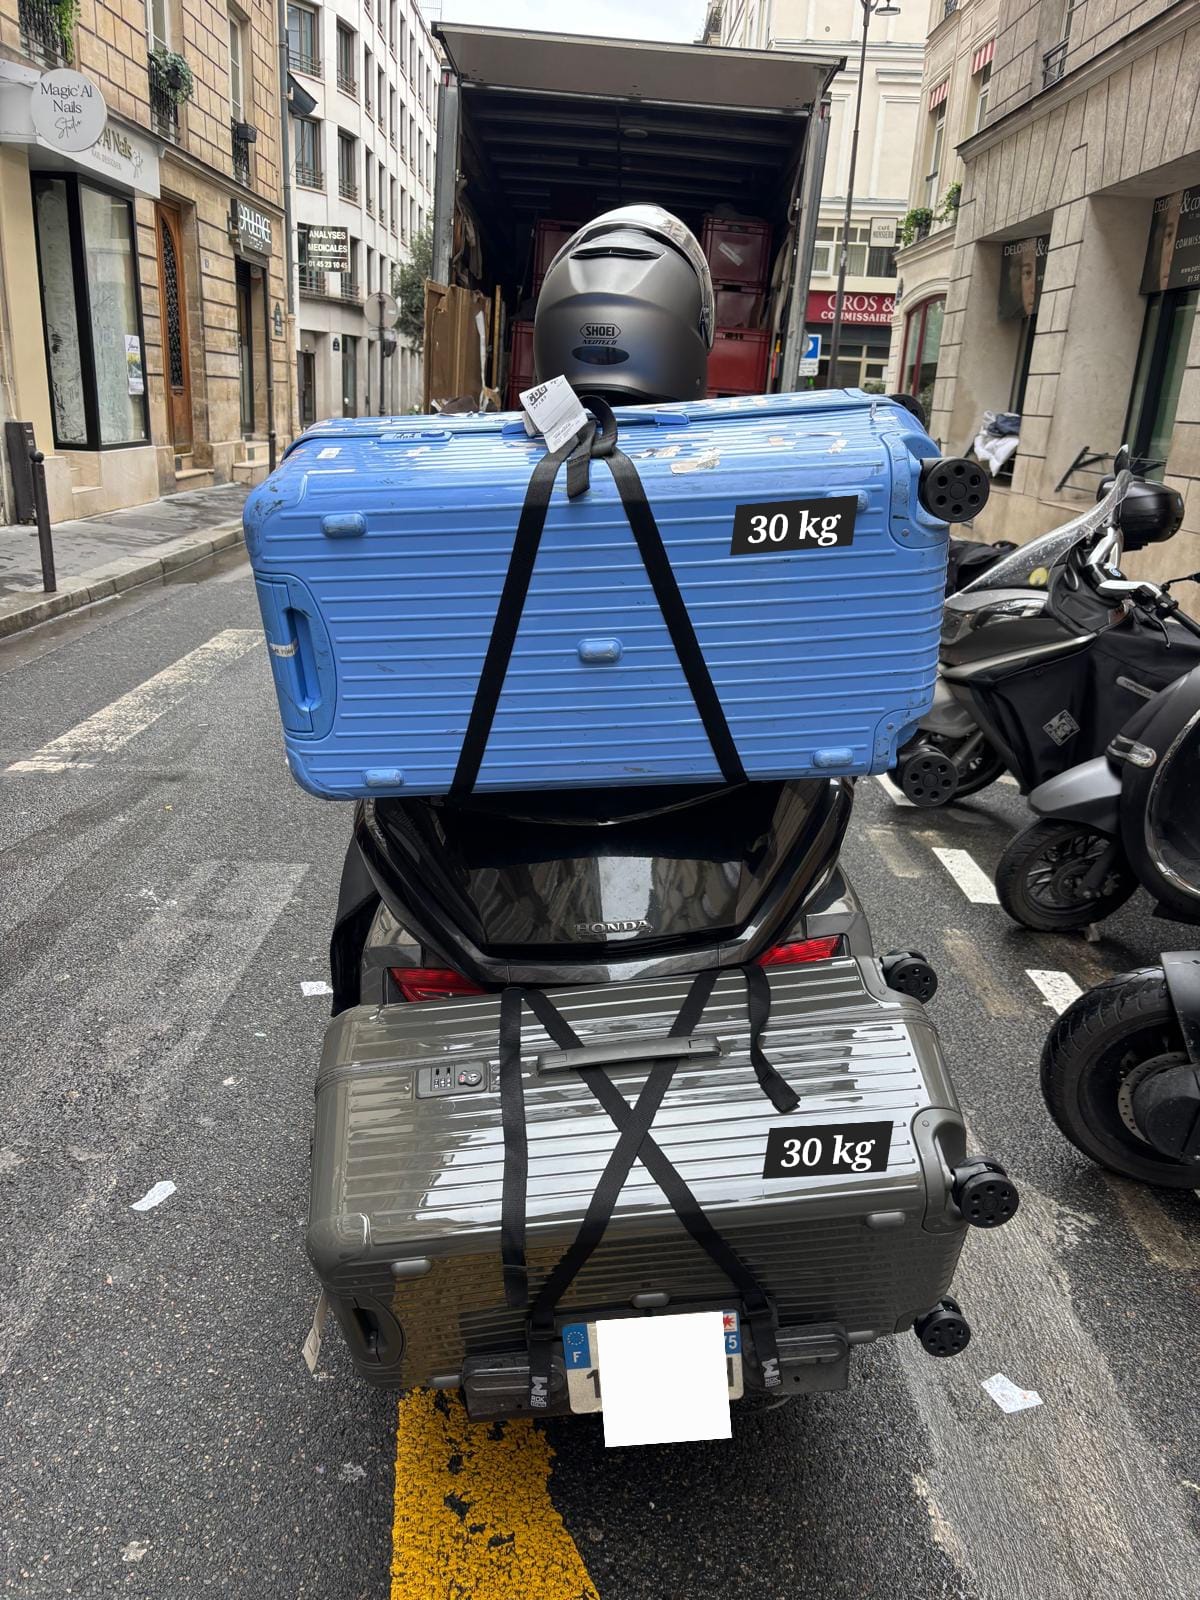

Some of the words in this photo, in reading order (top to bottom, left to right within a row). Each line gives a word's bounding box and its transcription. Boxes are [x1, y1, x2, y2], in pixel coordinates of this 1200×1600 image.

[53, 100, 82, 113] Nails
[309, 230, 346, 240] ANALYSES
[308, 243, 348, 253] MEDICALES
[585, 325, 615, 337] SHOEI
[575, 920, 653, 935] HONDA
[572, 1351, 582, 1363] F
